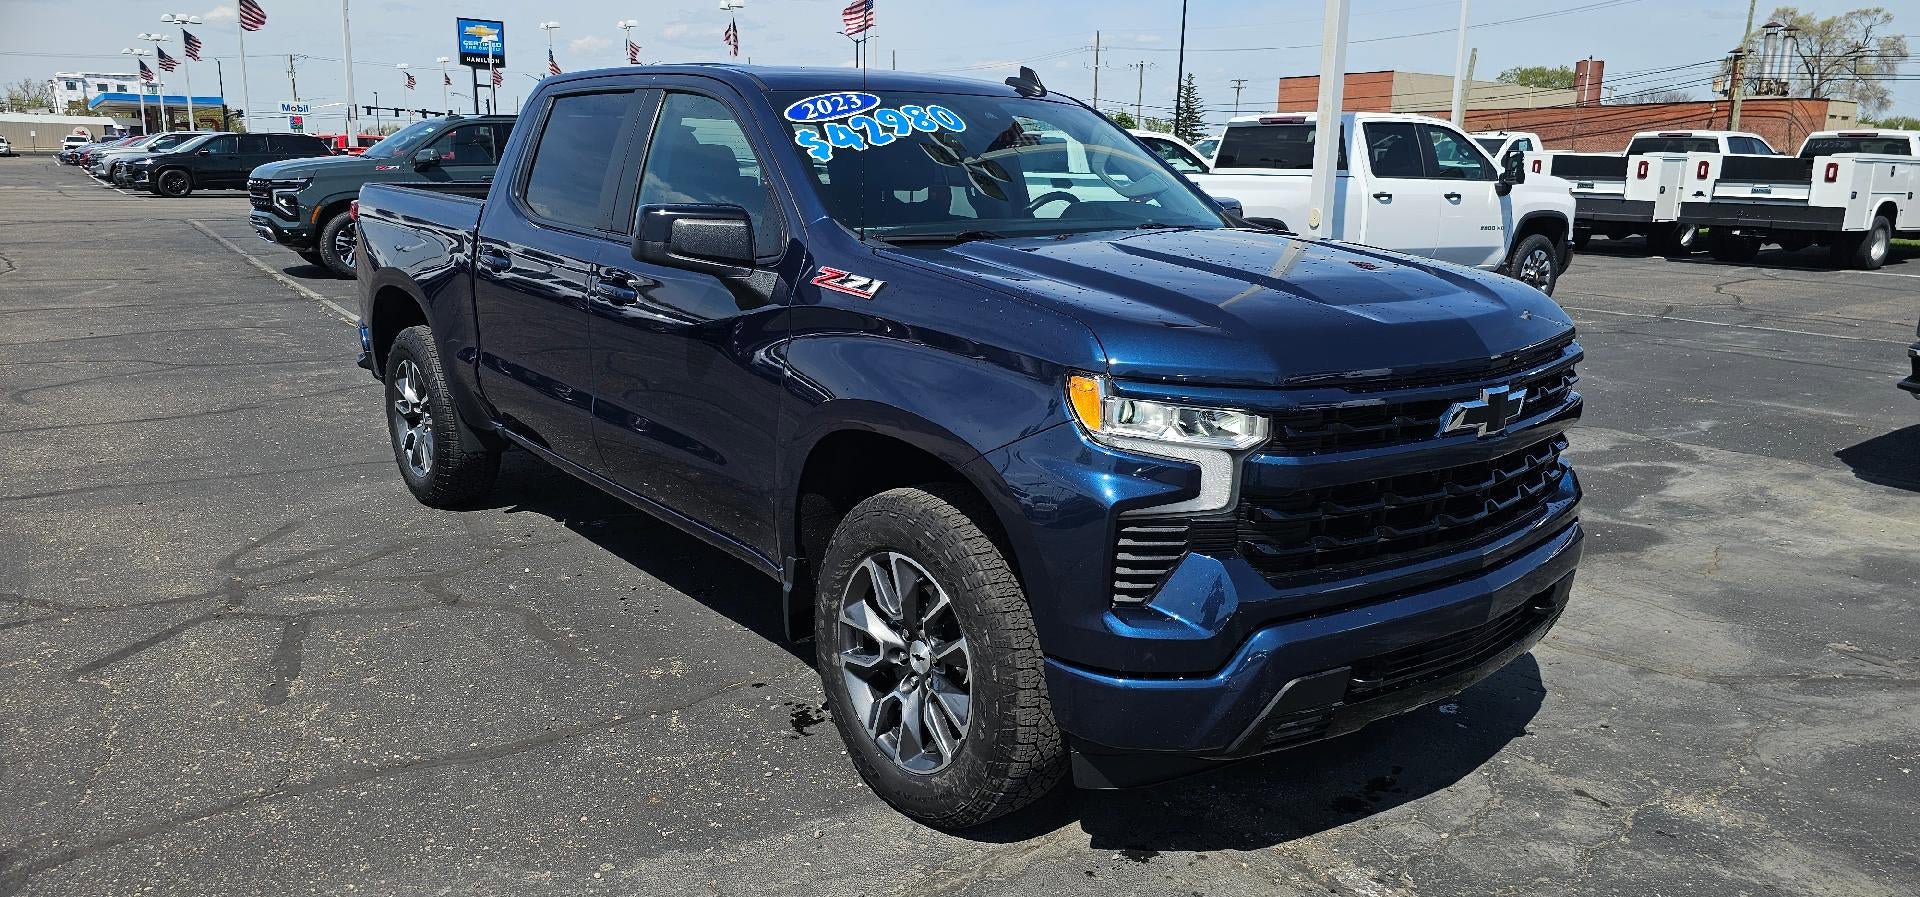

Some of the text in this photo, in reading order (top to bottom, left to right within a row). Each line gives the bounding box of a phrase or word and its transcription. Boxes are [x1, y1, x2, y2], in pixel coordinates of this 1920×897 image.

[281, 104, 309, 112] Mobil
[802, 94, 862, 120] 2023
[795, 105, 966, 162] $42980
[810, 265, 887, 300] Z71
